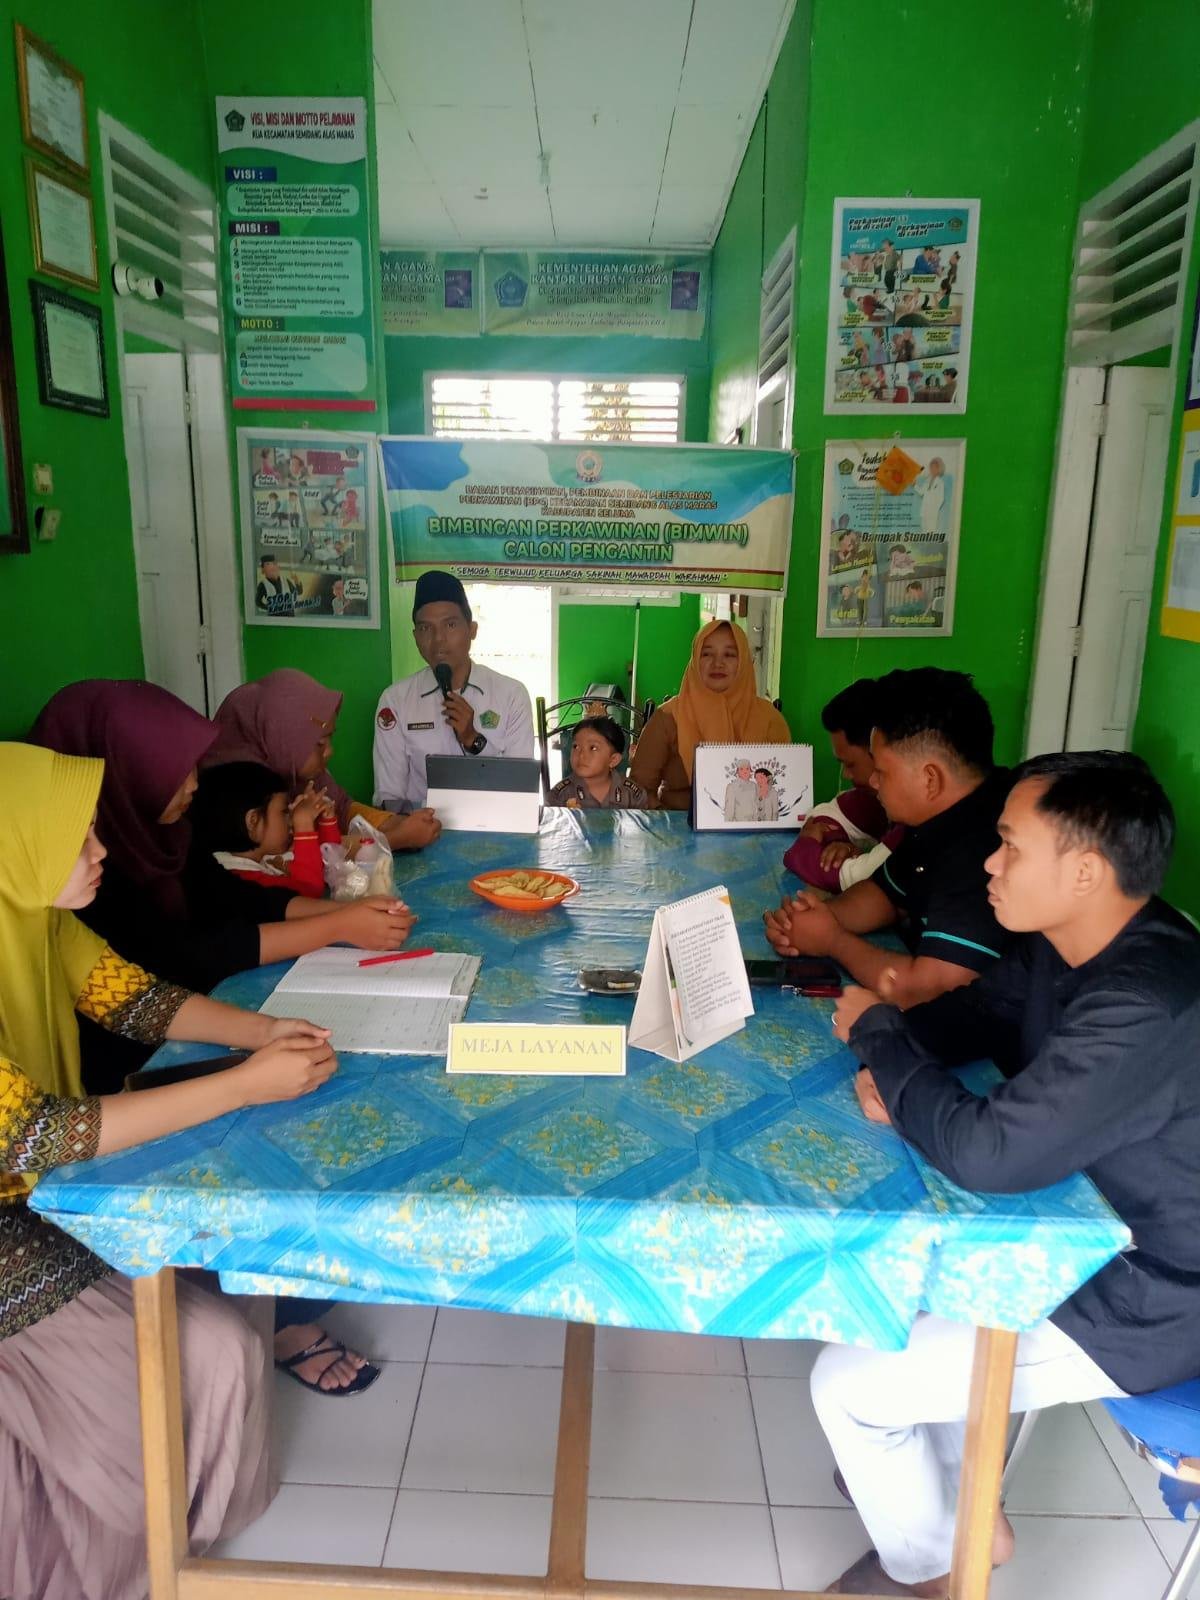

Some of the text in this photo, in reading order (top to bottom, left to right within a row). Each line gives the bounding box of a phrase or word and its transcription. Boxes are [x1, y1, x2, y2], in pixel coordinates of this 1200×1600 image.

[266, 112, 279, 126] MISI
[281, 112, 294, 126] DAN
[296, 112, 318, 126] MOTTO
[233, 170, 255, 180] VISI
[235, 223, 261, 233] MISI
[394, 262, 434, 271] AGAMA
[538, 263, 664, 274] KEMENTERIAN AGAMA
[401, 273, 441, 282] AGAMA
[531, 273, 668, 284] KANTOR URUSAN AGAMA
[241, 319, 273, 329] MOTTO
[465, 485, 499, 495] BADAN
[569, 487, 625, 498] PEMBINAAN
[627, 489, 648, 499] DAN
[650, 490, 712, 500] PELESTARIAN
[459, 495, 521, 505] PERKAWINAN
[550, 497, 606, 508] KECAMATAN
[608, 498, 657, 509] SEMIDANG
[658, 500, 682, 510] ALAS
[685, 501, 718, 511] MARAS
[541, 506, 636, 518] KABUPATEN SELUMA
[428, 516, 749, 547] BIMBINGAN PERKAWINAN (BIMWIN)
[861, 531, 946, 544] Dampak Stunting
[504, 540, 674, 563] CALON PENGANTIN
[457, 567, 489, 575] SEMOGA
[494, 568, 536, 576] TERWUJUD
[538, 568, 583, 577] KELUARGA
[461, 1038, 614, 1056] MEJA LAYANAN
